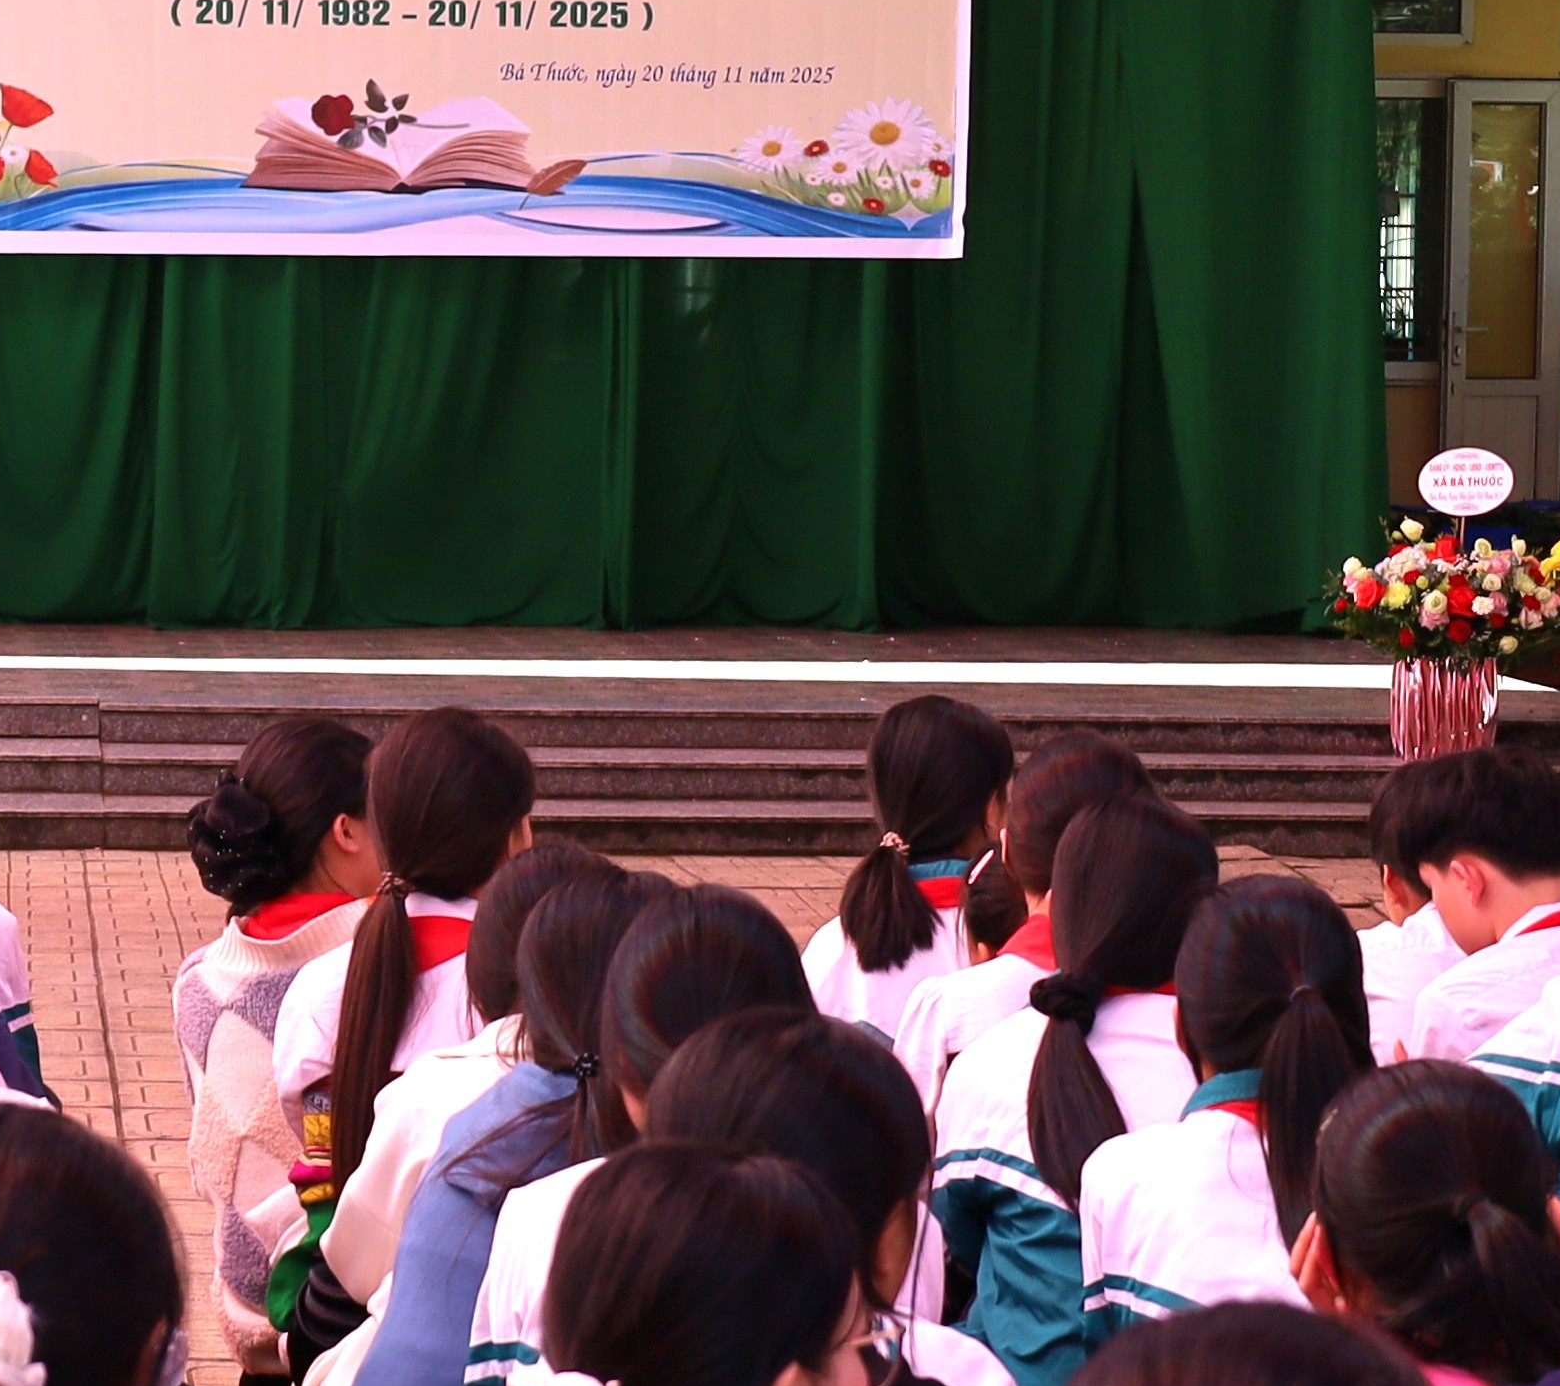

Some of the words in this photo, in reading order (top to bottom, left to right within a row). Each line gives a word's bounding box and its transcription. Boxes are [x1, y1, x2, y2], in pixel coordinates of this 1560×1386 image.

[317, 0, 391, 26] 1982
[428, 0, 482, 30] 20/
[549, 1, 629, 28] 2025
[500, 63, 525, 81] Bá
[530, 61, 588, 83] Thước,
[595, 63, 638, 89] ngày
[642, 64, 664, 83] 20
[670, 63, 718, 89] tháng
[723, 66, 743, 84] 11
[750, 67, 785, 84] năm
[790, 66, 835, 85] 2025
